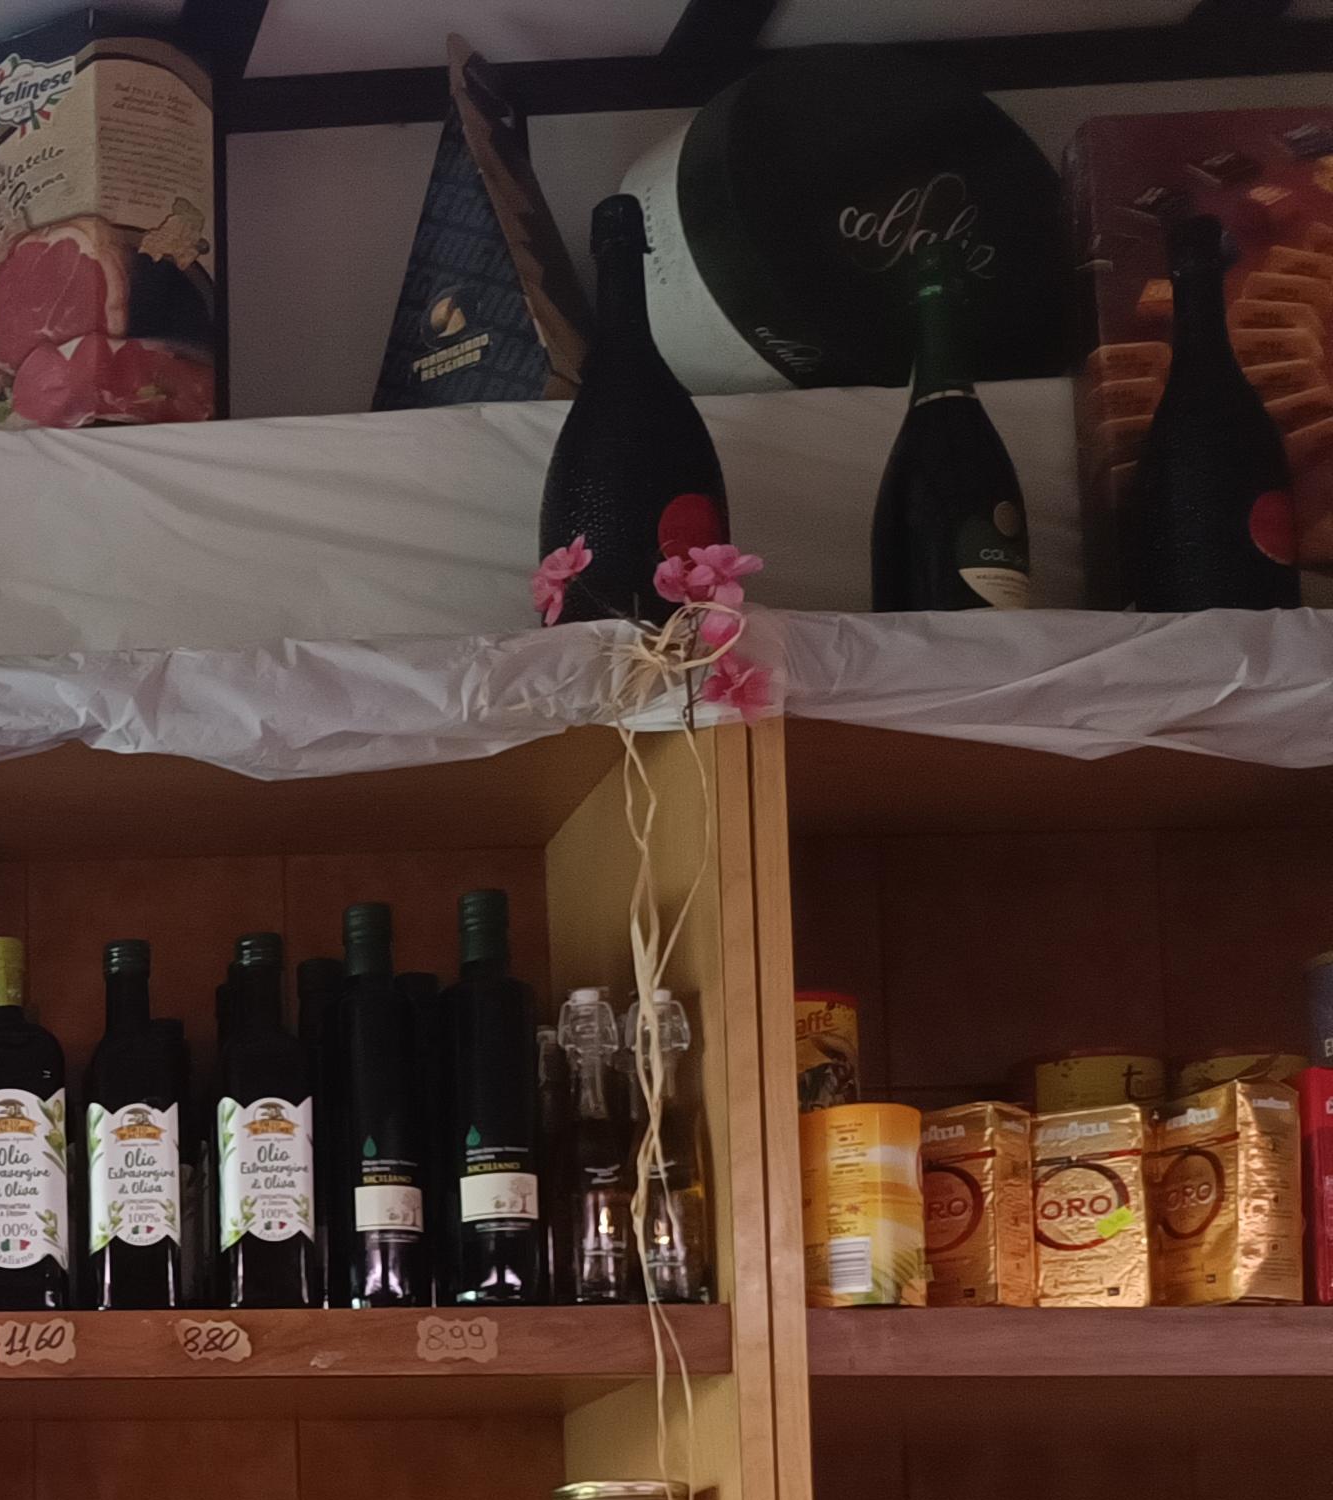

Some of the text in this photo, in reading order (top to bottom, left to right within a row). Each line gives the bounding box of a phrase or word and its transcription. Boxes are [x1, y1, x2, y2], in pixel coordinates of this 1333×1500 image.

[124, 1148, 157, 1168] Olio
[257, 1143, 291, 1163] Olio
[5, 1180, 39, 1197] Oliva
[132, 1180, 163, 1194] Oliva
[264, 1176, 296, 1189] Oliva
[1040, 1194, 1113, 1221] ORO
